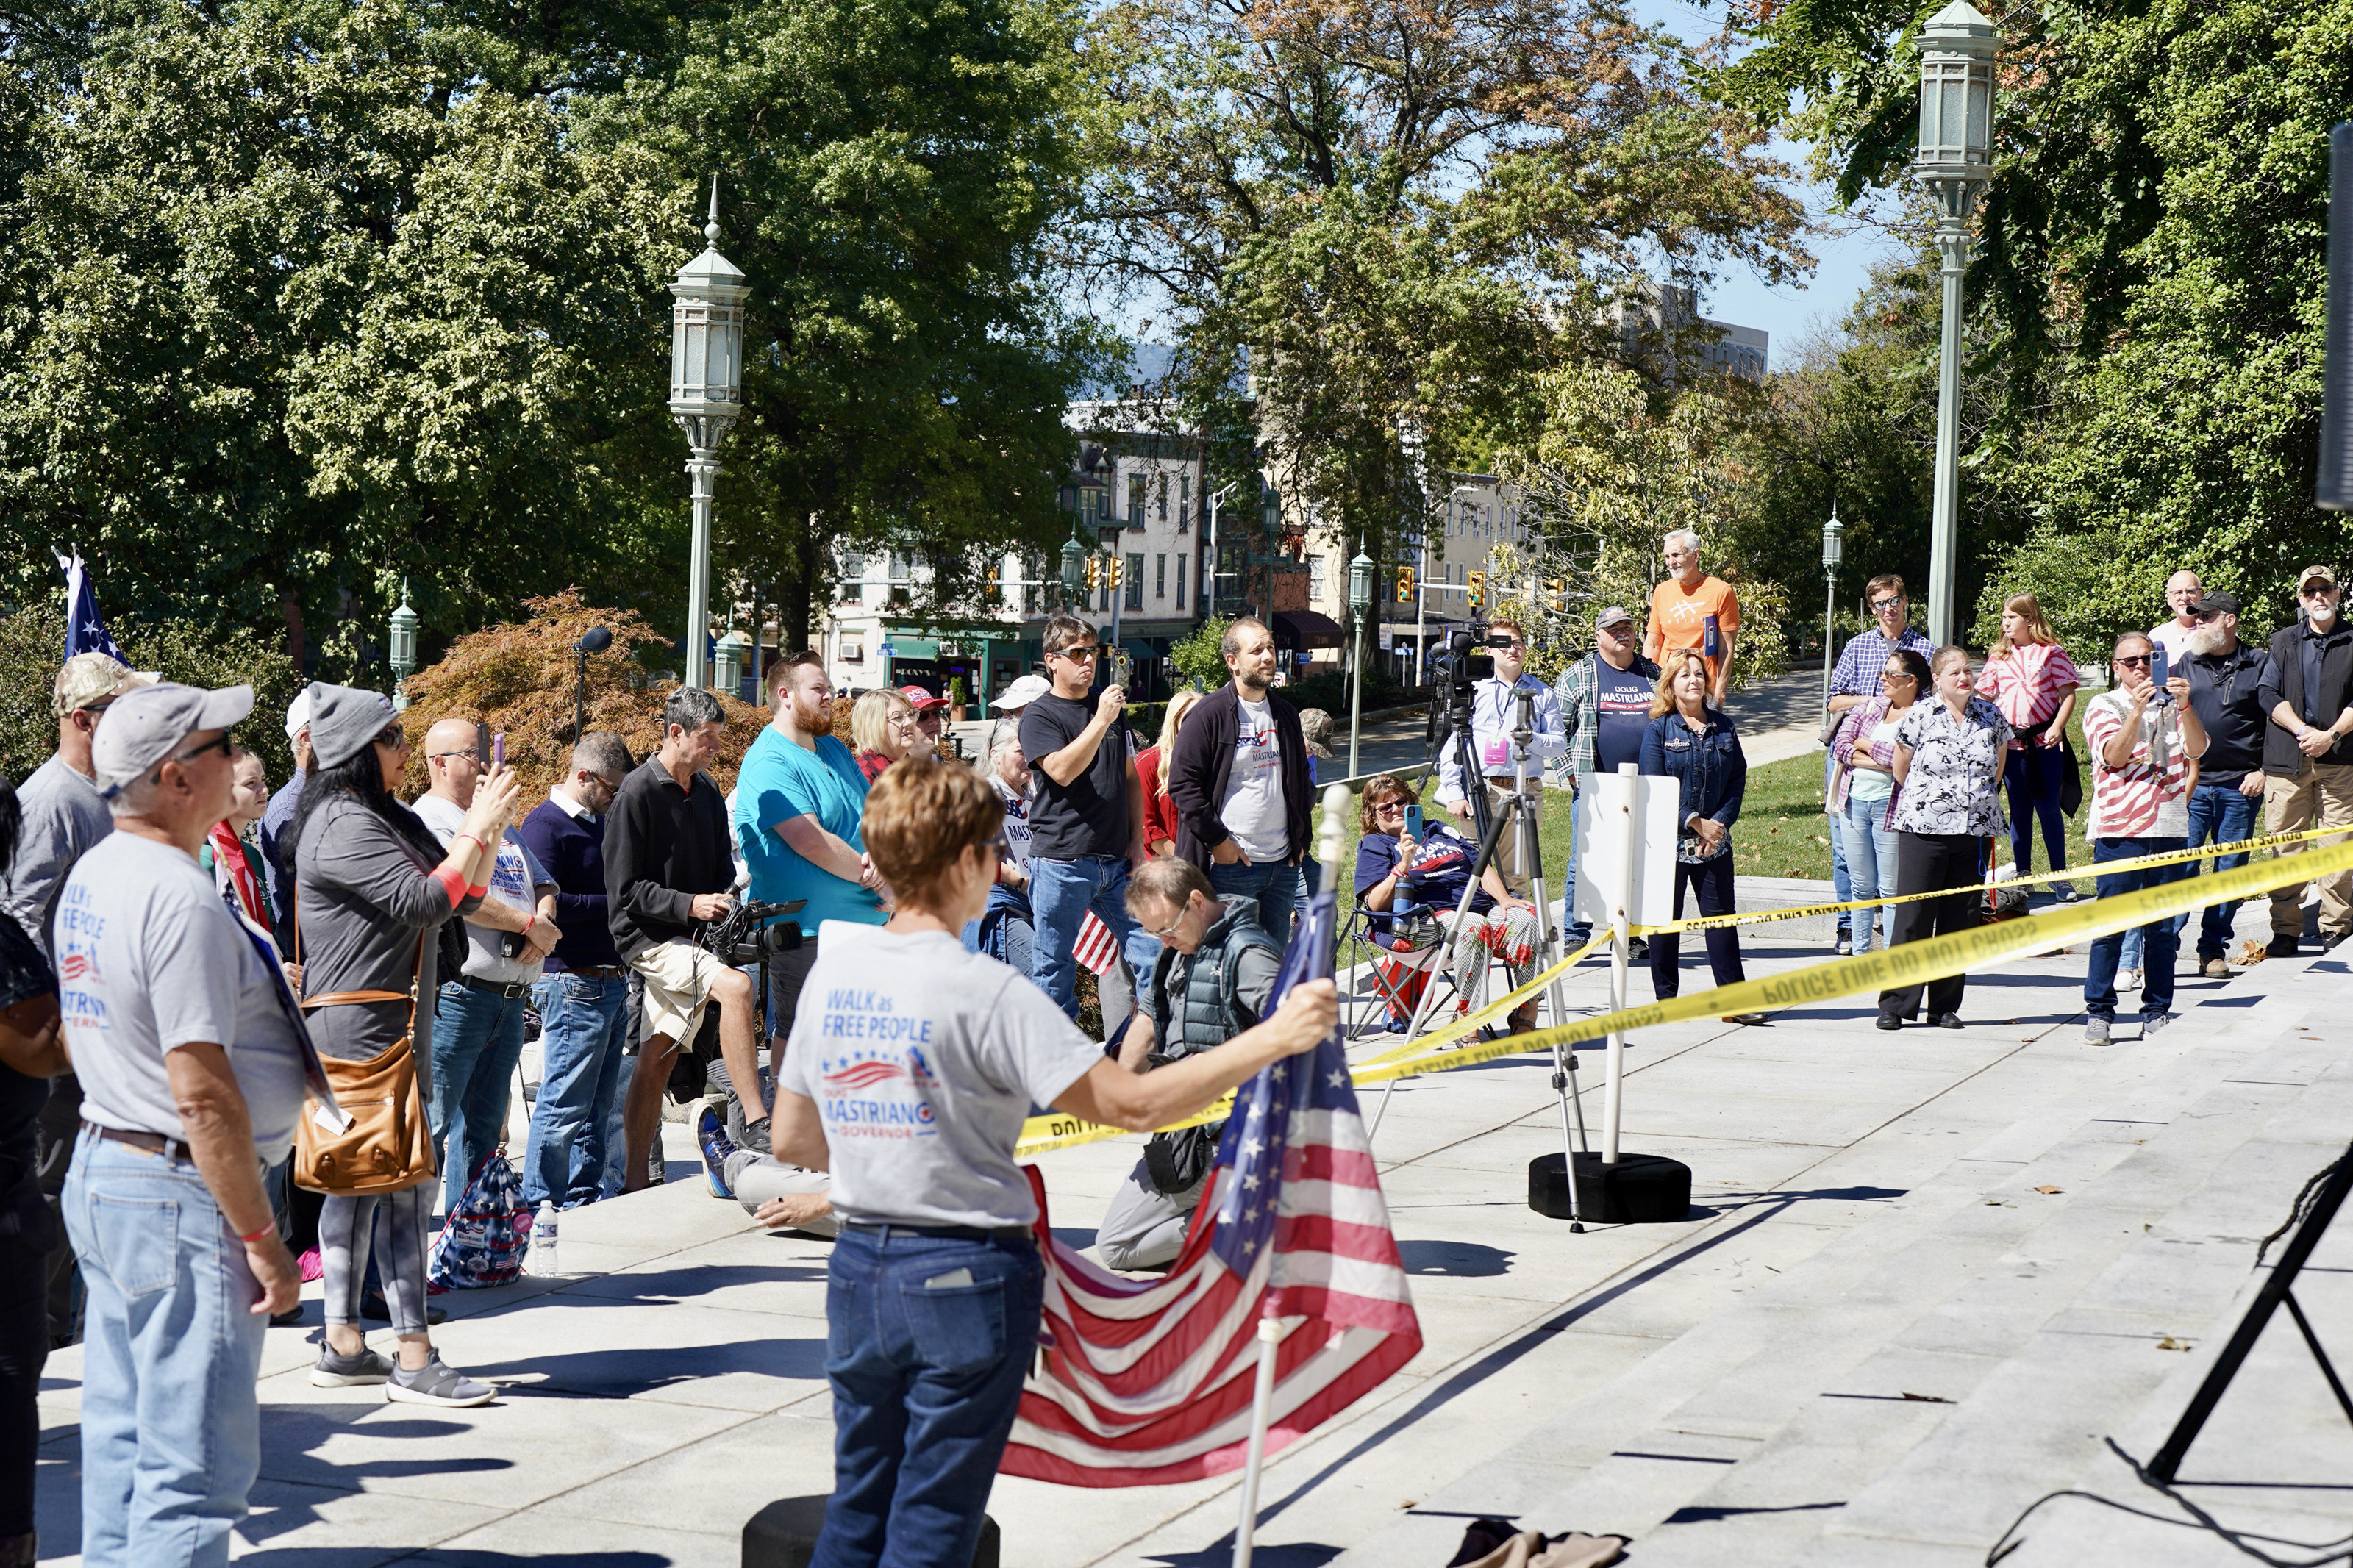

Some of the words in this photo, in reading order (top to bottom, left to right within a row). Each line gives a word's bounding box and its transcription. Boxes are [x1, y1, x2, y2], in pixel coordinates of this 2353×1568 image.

[1600, 692, 1656, 703] MASTRIANO
[1253, 750, 1282, 762] MASTRIAN
[1008, 825, 1032, 841] MAST
[493, 870, 524, 882] OVERNOR
[490, 878, 524, 890] DELROSSO
[827, 989, 876, 1012] WALK
[877, 997, 892, 1012] as
[822, 1014, 865, 1038] FREE
[868, 1016, 932, 1043] PEOPLE
[840, 1125, 913, 1139] GOVERNOR
